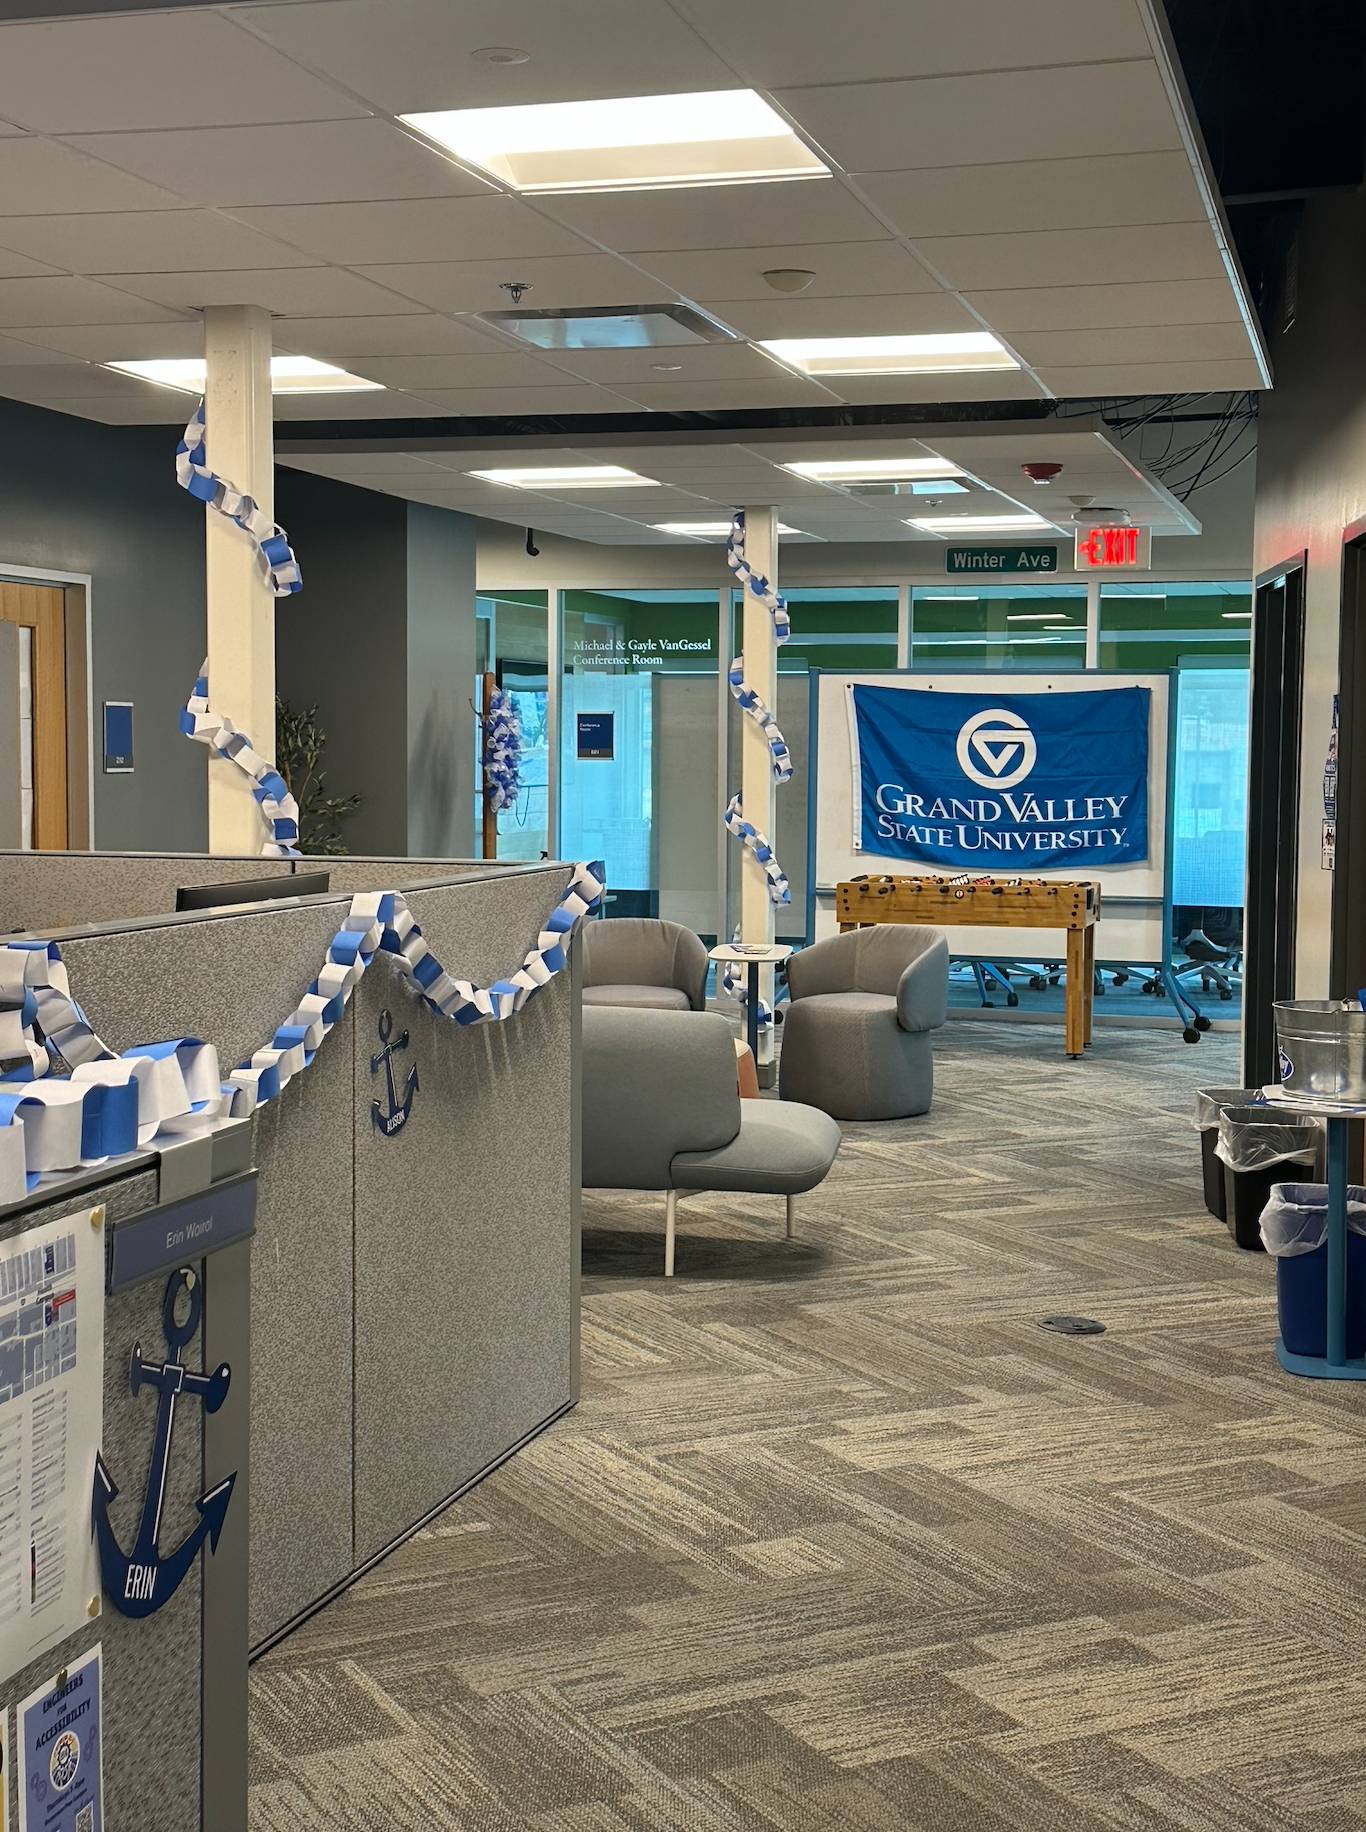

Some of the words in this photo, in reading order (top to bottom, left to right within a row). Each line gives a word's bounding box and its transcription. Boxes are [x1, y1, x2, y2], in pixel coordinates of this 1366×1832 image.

[953, 552, 1005, 568] Winter
[1017, 552, 1050, 568] Ave
[1088, 528, 1140, 567] EXIT
[573, 640, 613, 650] Michael
[616, 641, 625, 650] &
[628, 639, 657, 653] Gayle
[659, 639, 711, 650] VanGessel
[573, 654, 630, 665] Conference
[632, 654, 663, 665] Room
[876, 783, 1002, 822] GRAND
[999, 793, 1128, 823] VALLEY
[878, 815, 952, 848] STATE
[956, 824, 1128, 851] UNIVERSITY
[166, 1230, 184, 1248] Erin
[124, 1563, 157, 1600] ERIN
[35, 1699, 91, 1751] ACCESSIBILITY
